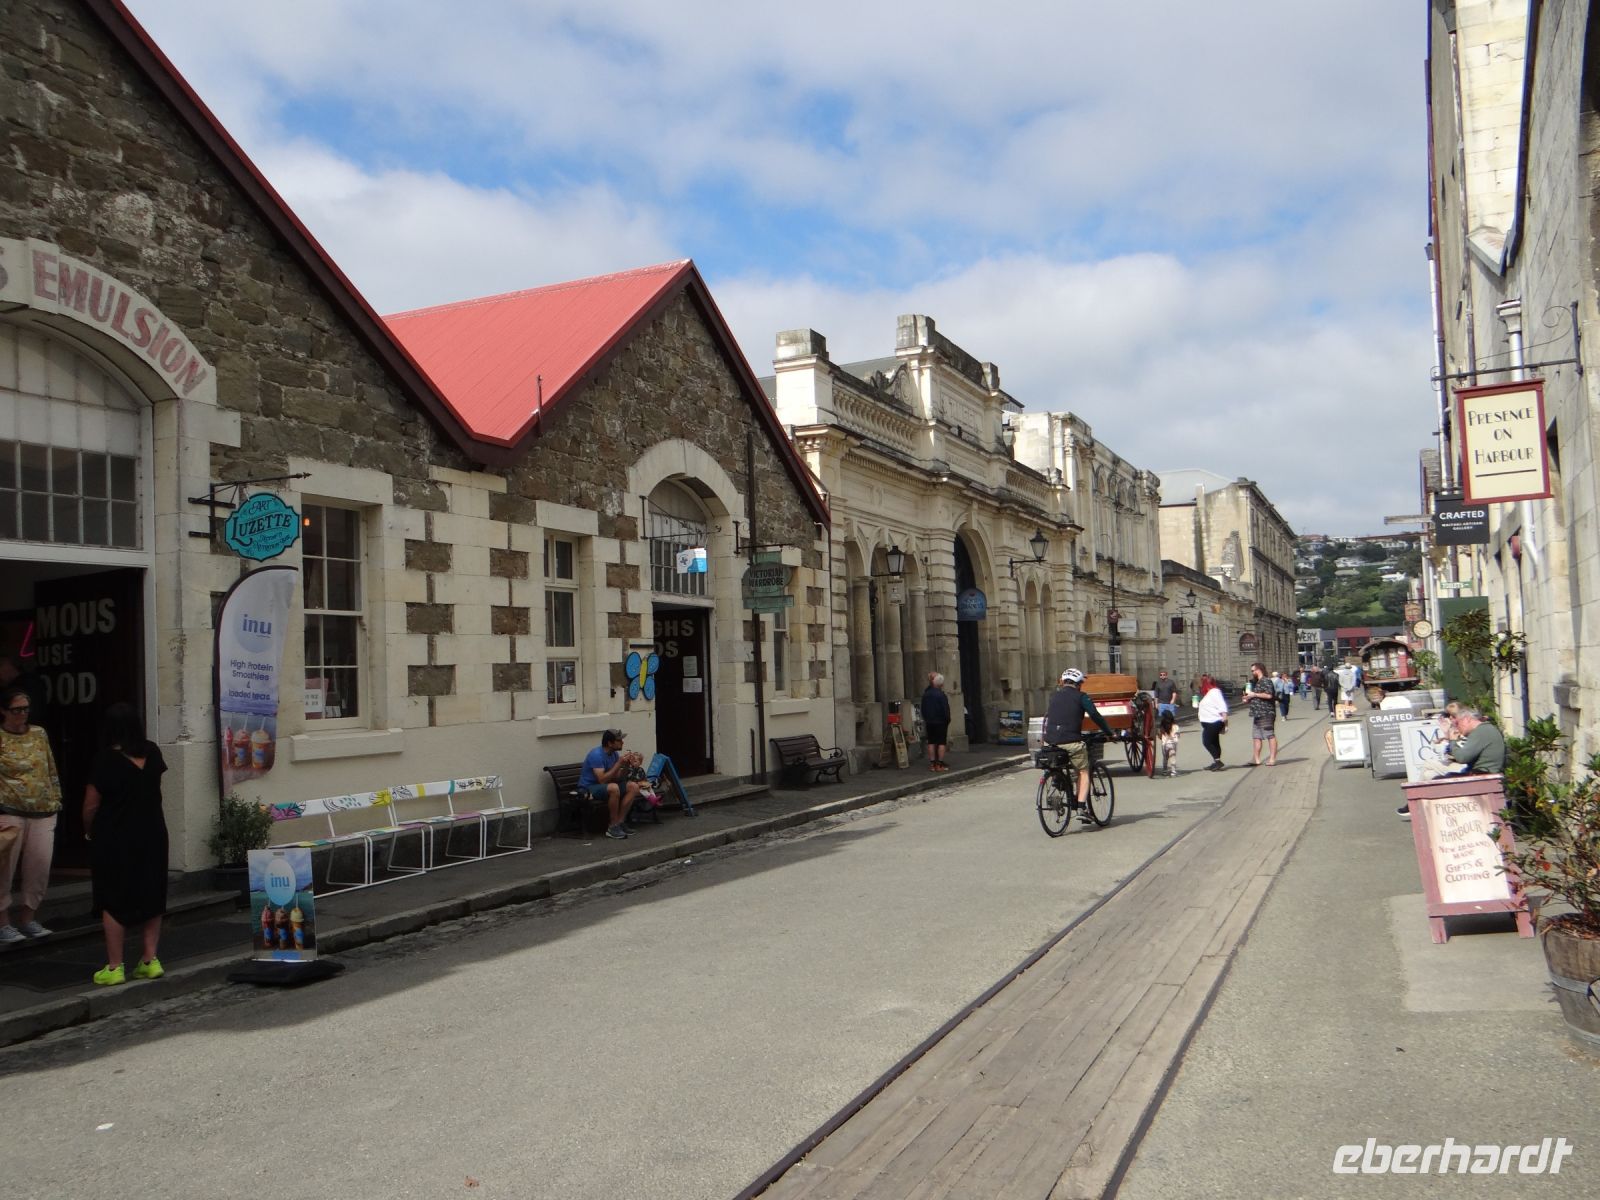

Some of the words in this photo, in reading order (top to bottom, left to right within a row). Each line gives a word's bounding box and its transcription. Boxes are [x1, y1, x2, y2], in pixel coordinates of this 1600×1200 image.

[32, 249, 208, 396] EMULSION
[1468, 407, 1534, 426] PRESENCE
[1494, 429, 1512, 441] ON
[1475, 447, 1534, 464] HARBOUR
[1439, 510, 1485, 520] CRAFTED
[231, 513, 292, 547] LUZETTE
[749, 567, 784, 578] VICTORIAN
[749, 577, 784, 588] WARDROBE
[243, 614, 272, 635] inu
[230, 659, 246, 669] High
[232, 670, 270, 681] Smoothies
[1369, 713, 1413, 723] CRAFTED
[1434, 801, 1479, 816] PRESENCE
[1445, 816, 1458, 828] ON
[1440, 819, 1484, 843] HARBOUR
[1446, 862, 1473, 873] GIFTS
[270, 873, 290, 888] inu
[1445, 870, 1491, 883] CLOTHING
